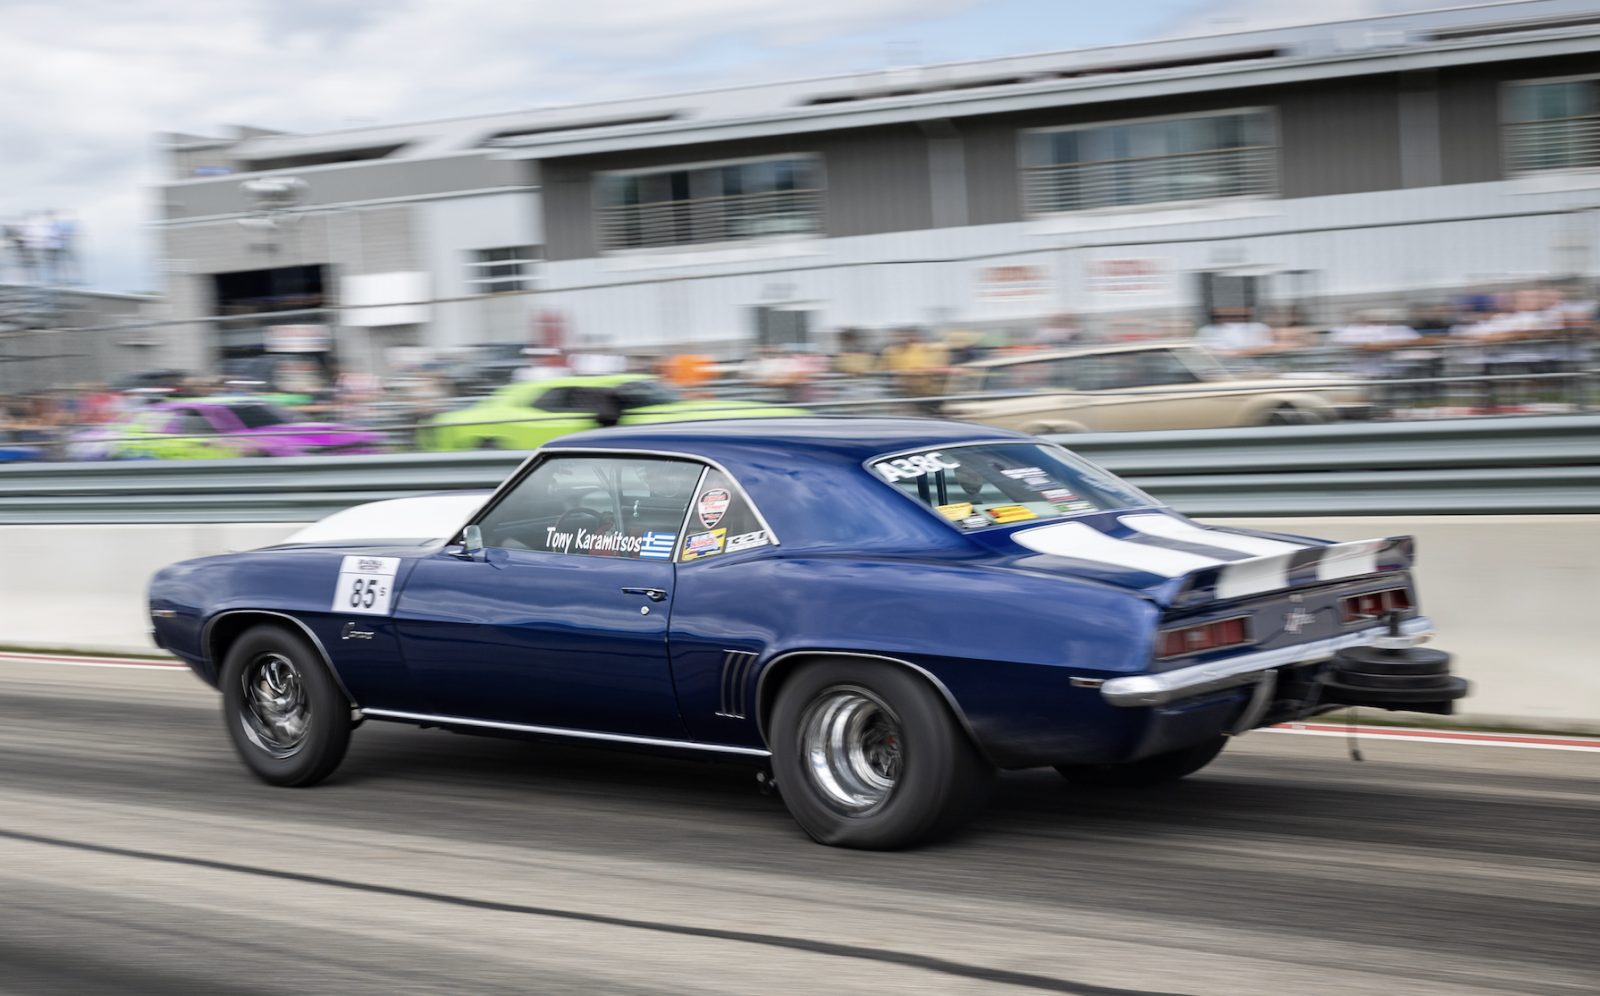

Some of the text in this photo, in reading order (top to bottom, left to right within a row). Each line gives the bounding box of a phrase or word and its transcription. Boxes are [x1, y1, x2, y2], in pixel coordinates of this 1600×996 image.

[875, 452, 960, 483] A38C
[546, 527, 642, 554] Tony Karamitsos
[350, 579, 377, 609] 85
